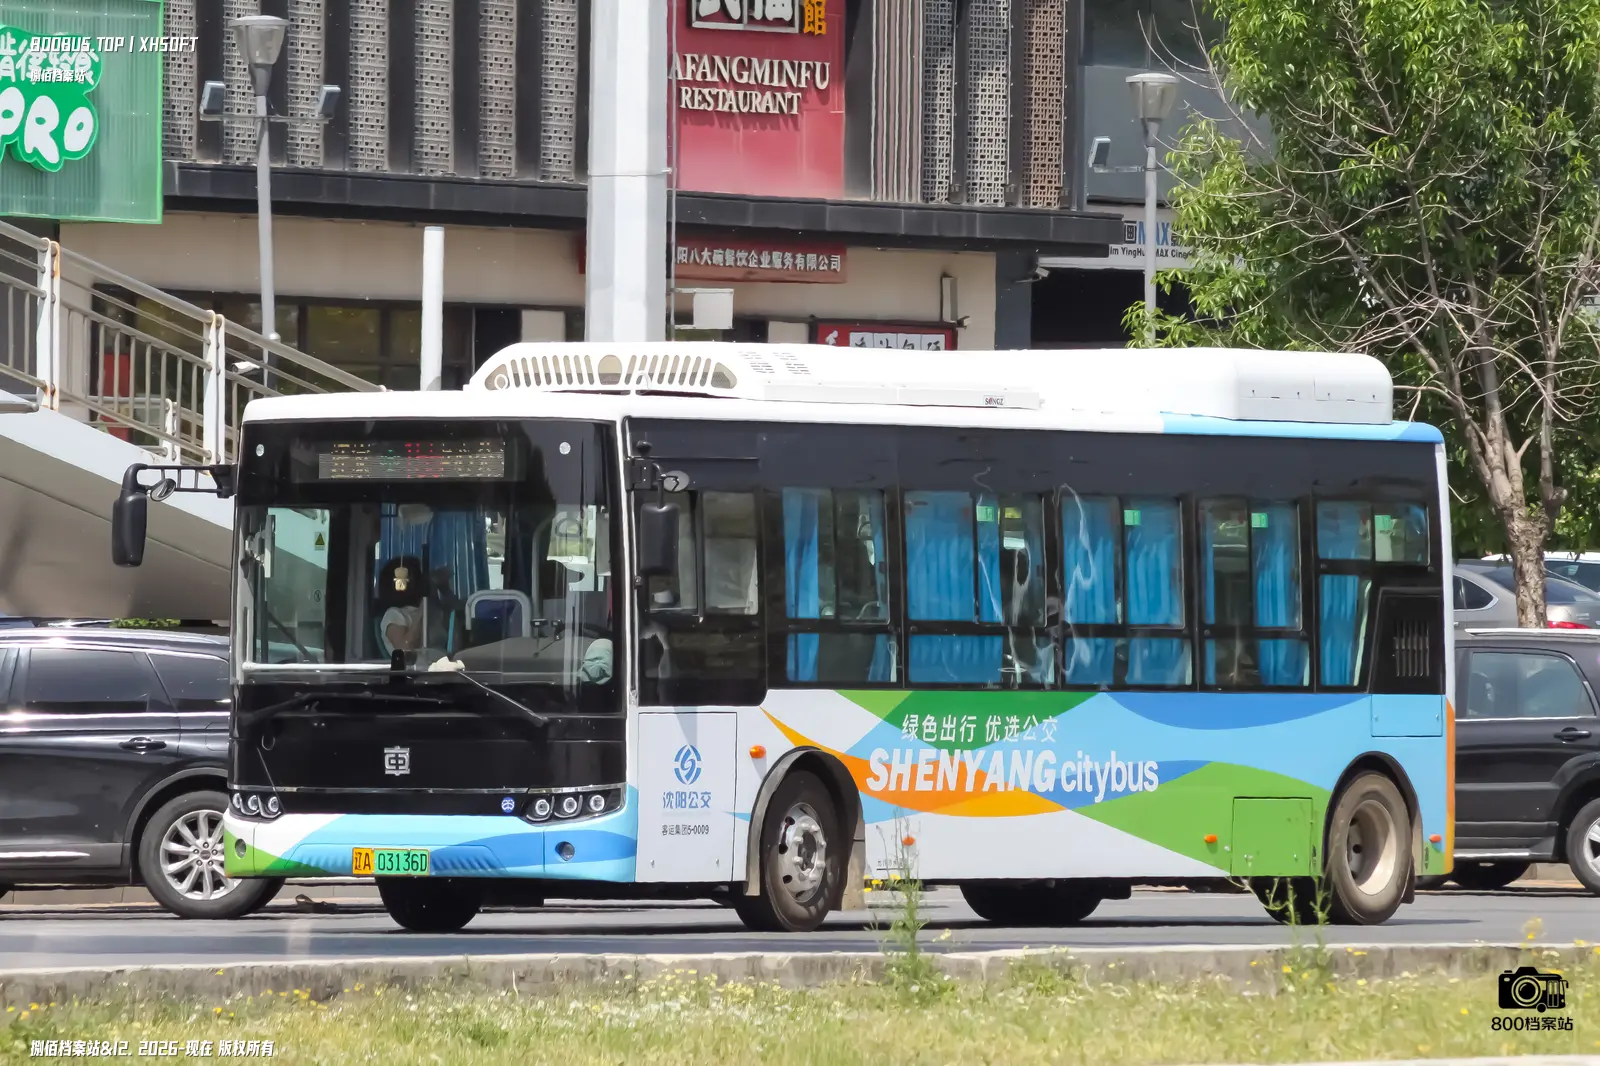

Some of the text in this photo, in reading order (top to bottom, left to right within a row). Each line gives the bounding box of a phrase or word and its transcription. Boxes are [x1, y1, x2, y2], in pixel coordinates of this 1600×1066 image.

[680, 86, 802, 115] RESTAURANT
[902, 713, 1058, 743] 绿色出行 优选公交
[866, 748, 1159, 803] SHENYANG citybus
[663, 791, 711, 809] 沈阳公交
[378, 852, 428, 872] 03136D
